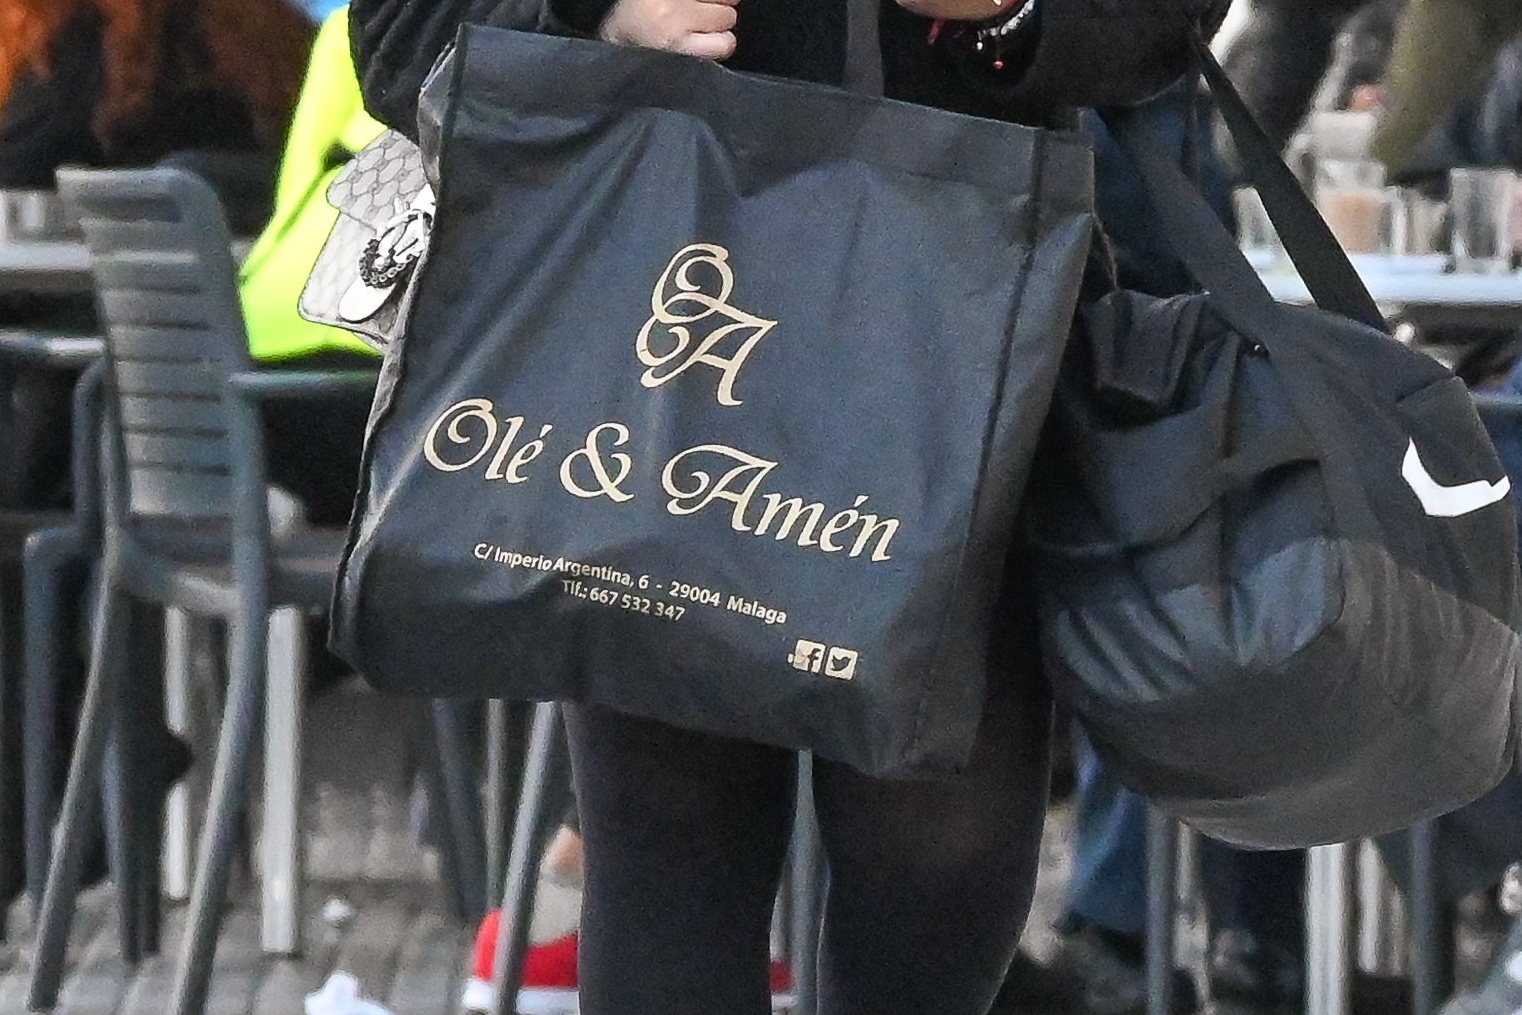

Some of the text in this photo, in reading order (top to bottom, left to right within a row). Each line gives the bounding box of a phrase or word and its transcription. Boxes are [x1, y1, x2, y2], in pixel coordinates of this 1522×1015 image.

[422, 397, 901, 562] Olé & Amén
[474, 543, 494, 560] C/
[494, 546, 553, 571] Imperio
[553, 557, 635, 588] Argentina,
[638, 574, 650, 590] 6
[668, 580, 721, 607] 29004
[726, 595, 788, 625] Malaga
[589, 587, 619, 606] 667
[620, 594, 652, 615] 532
[653, 601, 686, 621] 347
